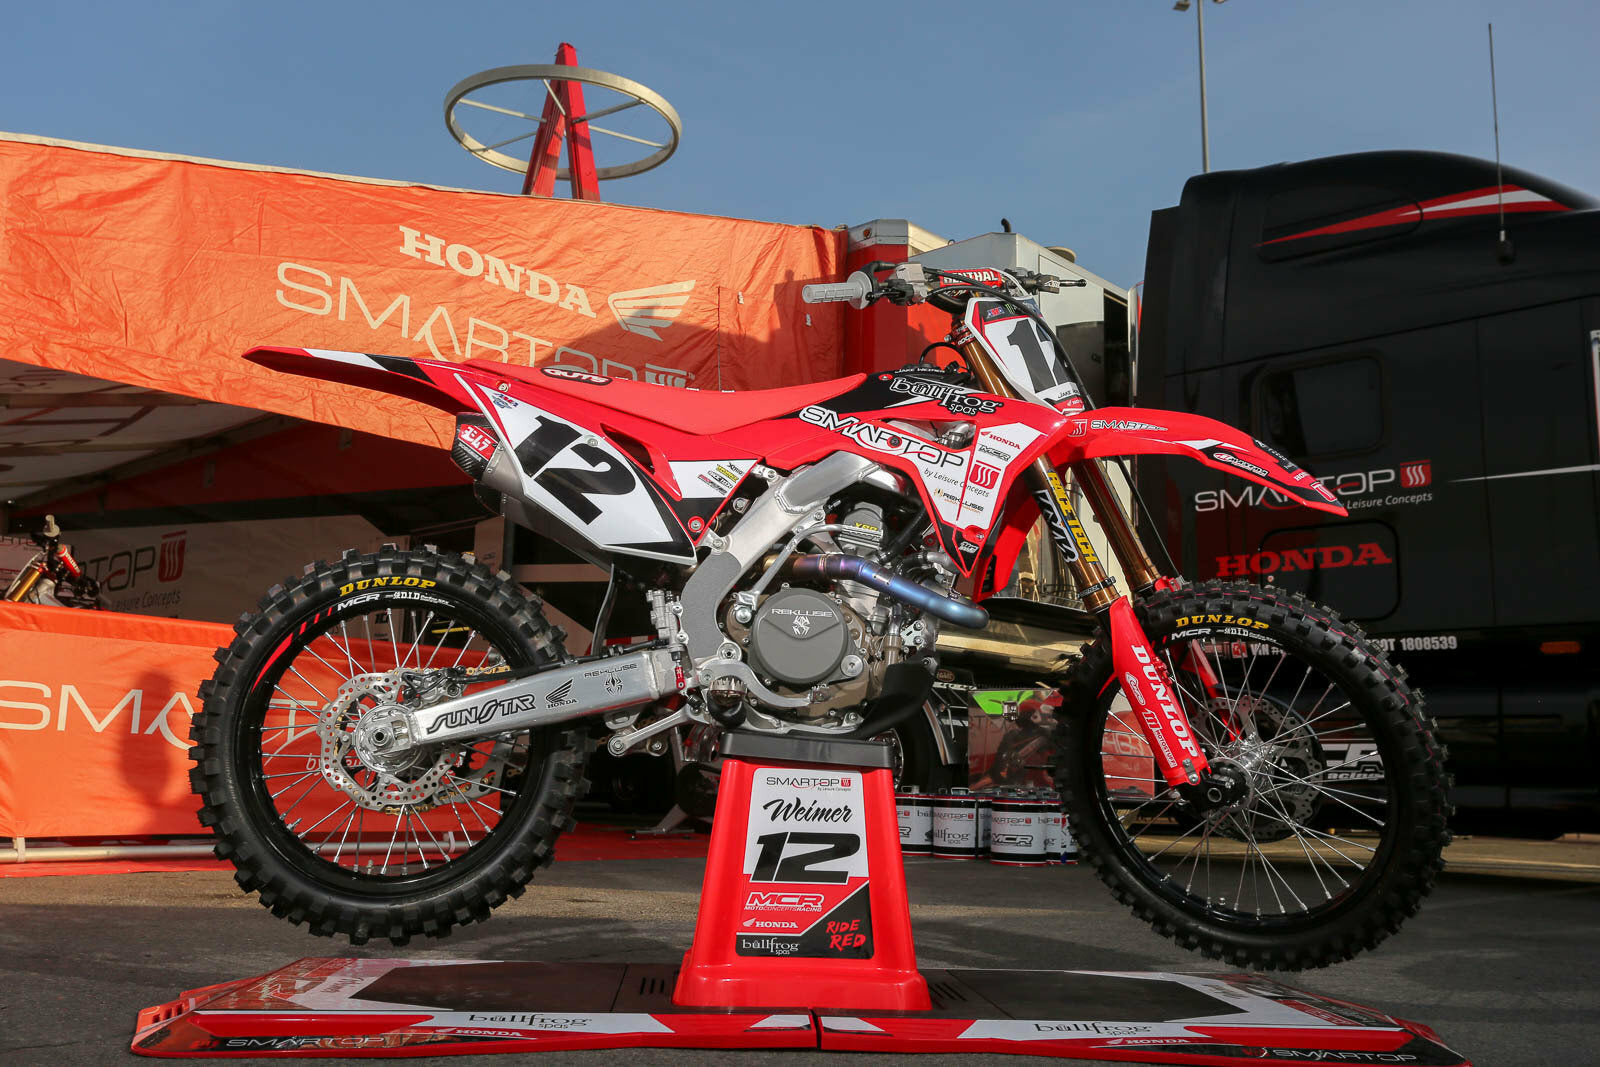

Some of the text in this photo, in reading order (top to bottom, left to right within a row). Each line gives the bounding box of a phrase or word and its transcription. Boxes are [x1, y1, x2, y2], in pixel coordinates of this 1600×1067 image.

[399, 226, 596, 319] HONDA
[949, 403, 977, 416] spas
[989, 434, 1021, 450] HONDA
[513, 414, 637, 526] 12
[934, 472, 959, 487] Leisure
[1346, 491, 1433, 511] Leisure Concepts
[1216, 542, 1392, 578] HONDA
[340, 576, 437, 597] DUNLOP
[337, 593, 380, 611] MCR
[771, 608, 833, 618] REKLUSE
[1175, 614, 1270, 630] DUNLOP
[1171, 627, 1212, 641] MCR
[1400, 635, 1458, 651] 1808539
[547, 699, 578, 710] HONDA
[1131, 645, 1200, 757] DUNLOP
[766, 776, 840, 787] SMARTOP
[763, 797, 853, 823] Weimer
[751, 831, 861, 884] 12
[745, 891, 825, 908] MCR
[755, 921, 799, 929] HONDA
[825, 919, 861, 935] RIDE
[829, 933, 867, 952] RED
[455, 1029, 523, 1037] HONDA
[226, 1037, 385, 1048] SMARTOP
[1272, 1049, 1418, 1062] SMARTOP
